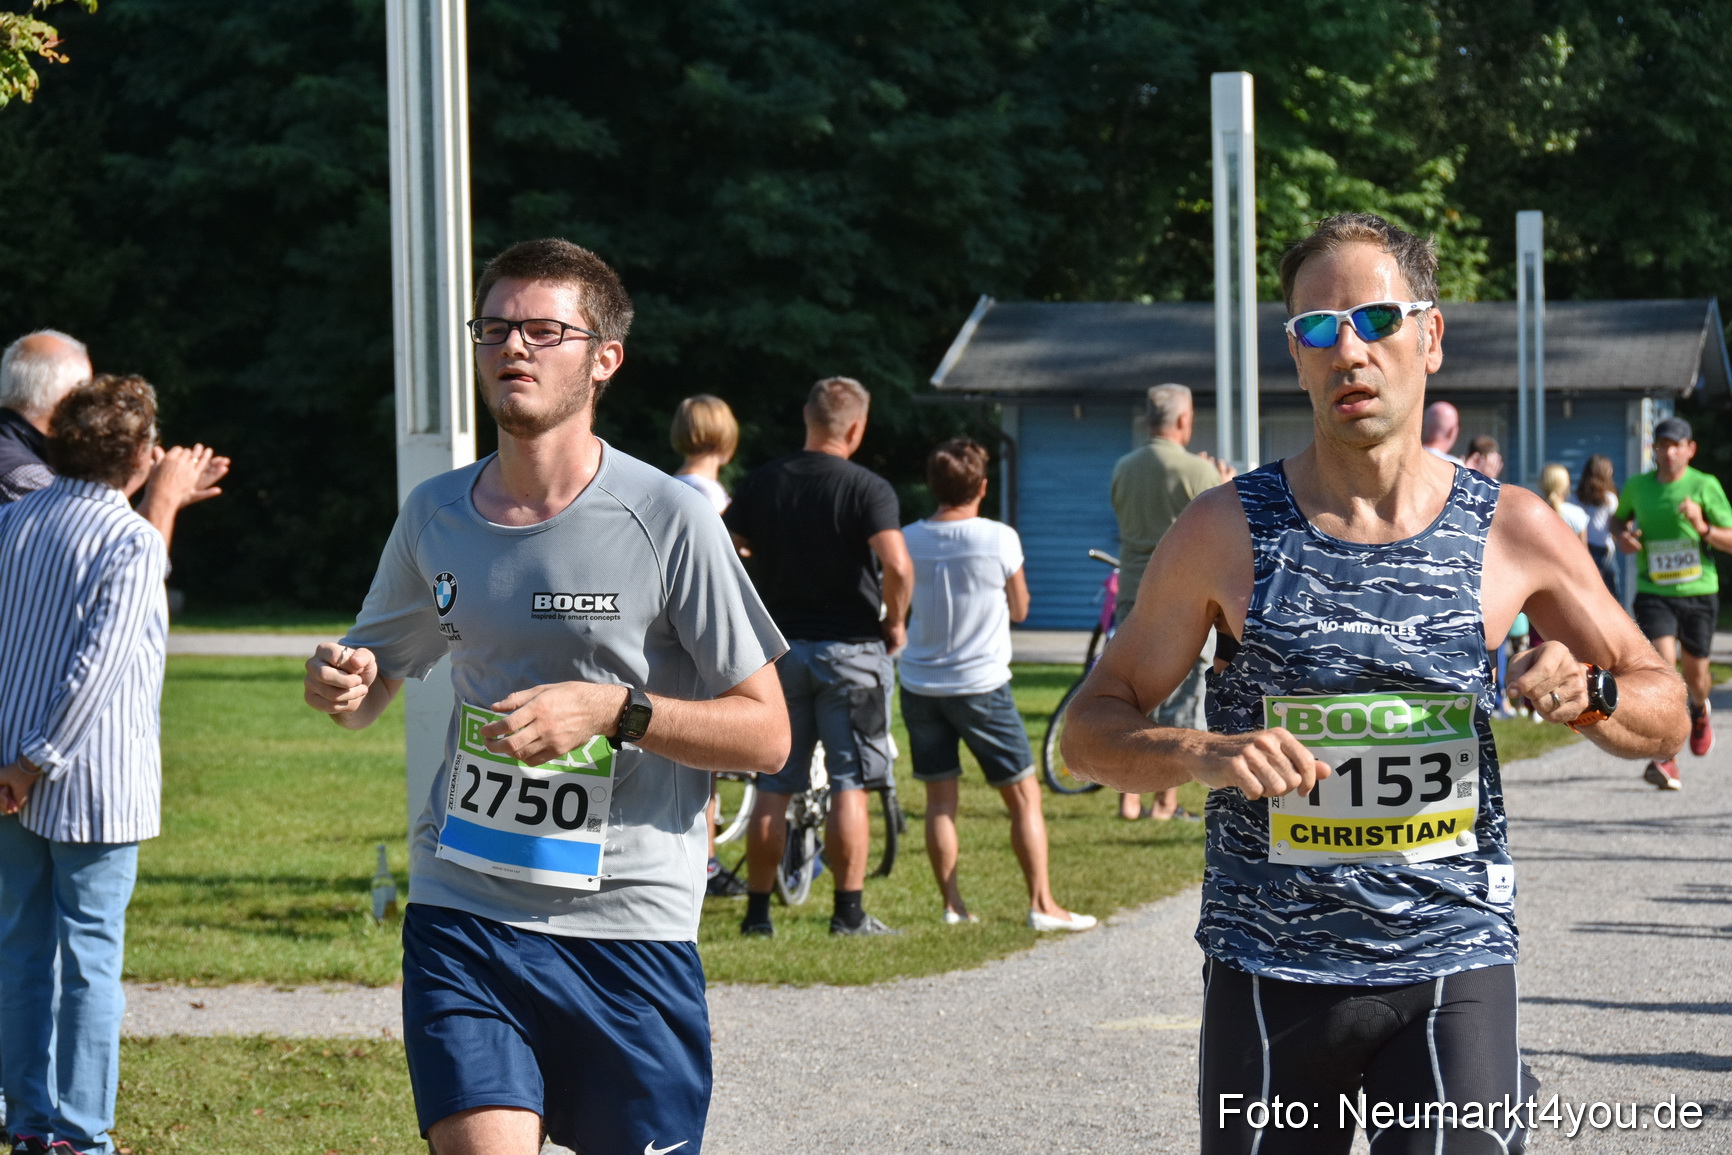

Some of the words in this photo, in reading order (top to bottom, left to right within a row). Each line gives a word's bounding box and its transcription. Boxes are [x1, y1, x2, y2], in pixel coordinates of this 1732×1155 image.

[532, 592, 620, 613] BOCK
[557, 613, 566, 621] by
[1317, 621, 1339, 632] NO
[1343, 622, 1416, 636] MIRACLES
[1281, 700, 1460, 741] BOCK
[1460, 753, 1469, 763] B
[460, 764, 589, 830] 2750
[1290, 818, 1457, 847] CHRISTIAN
